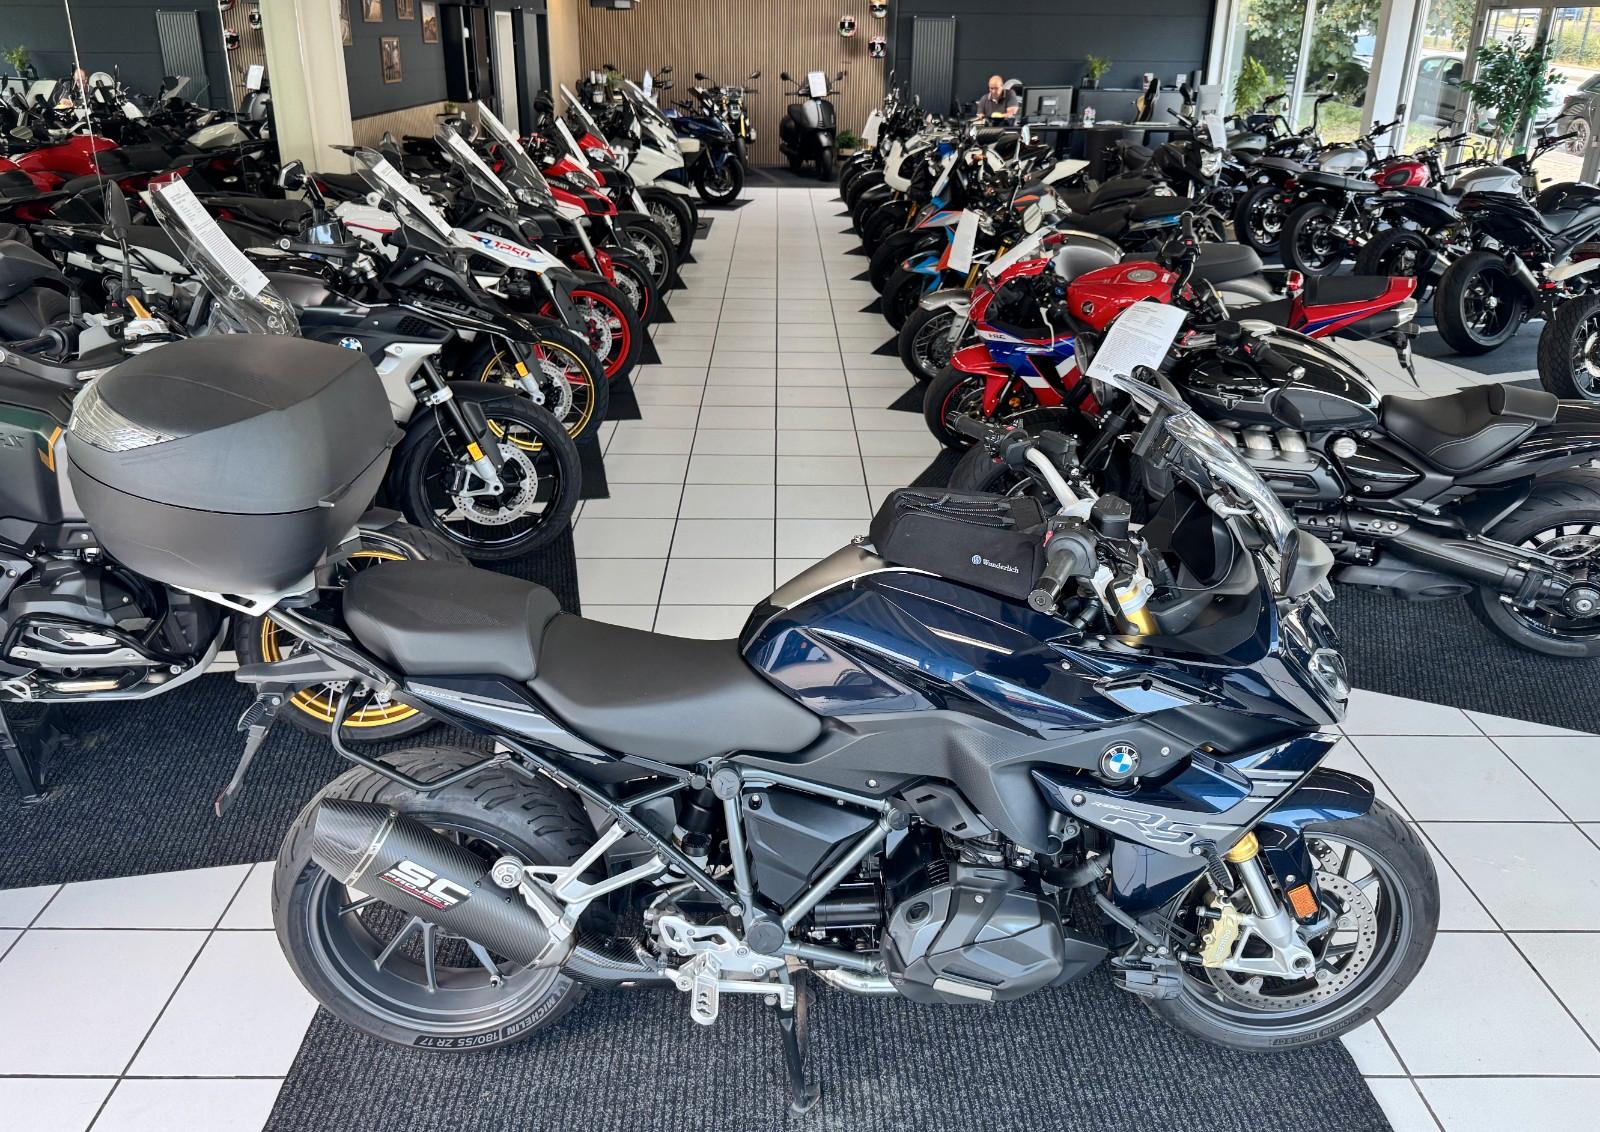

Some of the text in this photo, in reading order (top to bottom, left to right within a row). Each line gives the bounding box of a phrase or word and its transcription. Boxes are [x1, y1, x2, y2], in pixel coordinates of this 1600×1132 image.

[982, 558, 1019, 573] Wunderlich
[389, 860, 472, 903] SC
[419, 996, 556, 1047] MICHELIN 180/55 ZR 17
